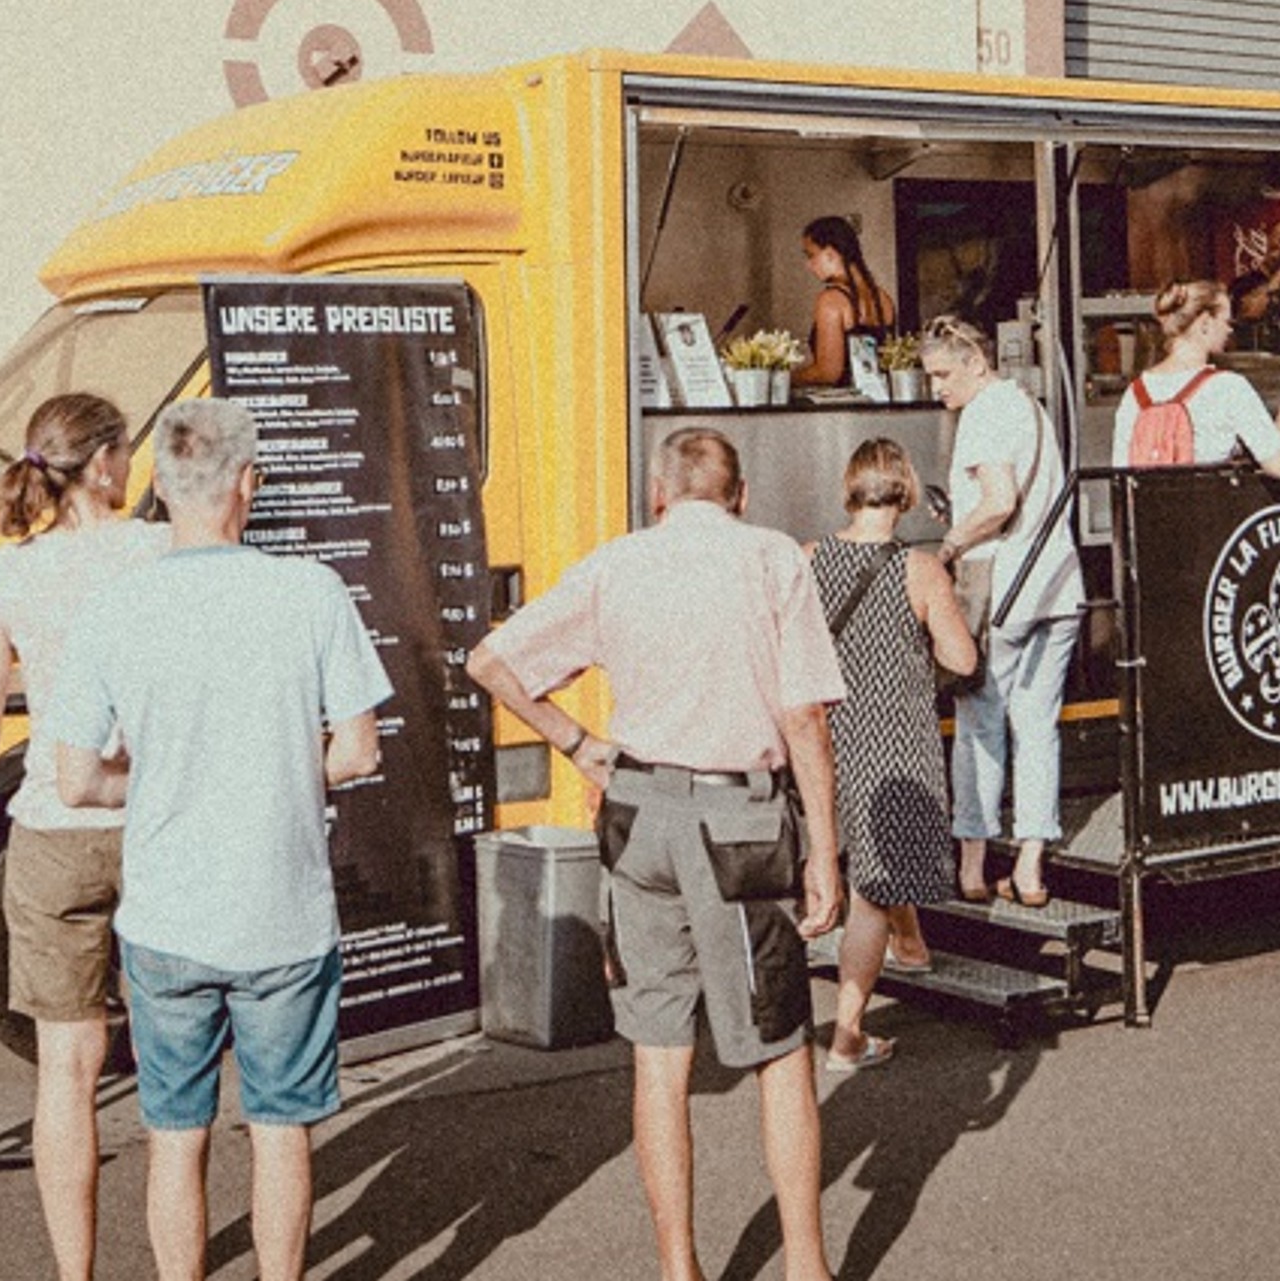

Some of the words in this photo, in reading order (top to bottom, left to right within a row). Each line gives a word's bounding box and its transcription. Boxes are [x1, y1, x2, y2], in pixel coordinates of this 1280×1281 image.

[220, 305, 319, 335] UNSERE
[324, 305, 457, 335] PREISLISTE
[1213, 576, 1244, 690] BURGER
[1229, 538, 1260, 576] LA
